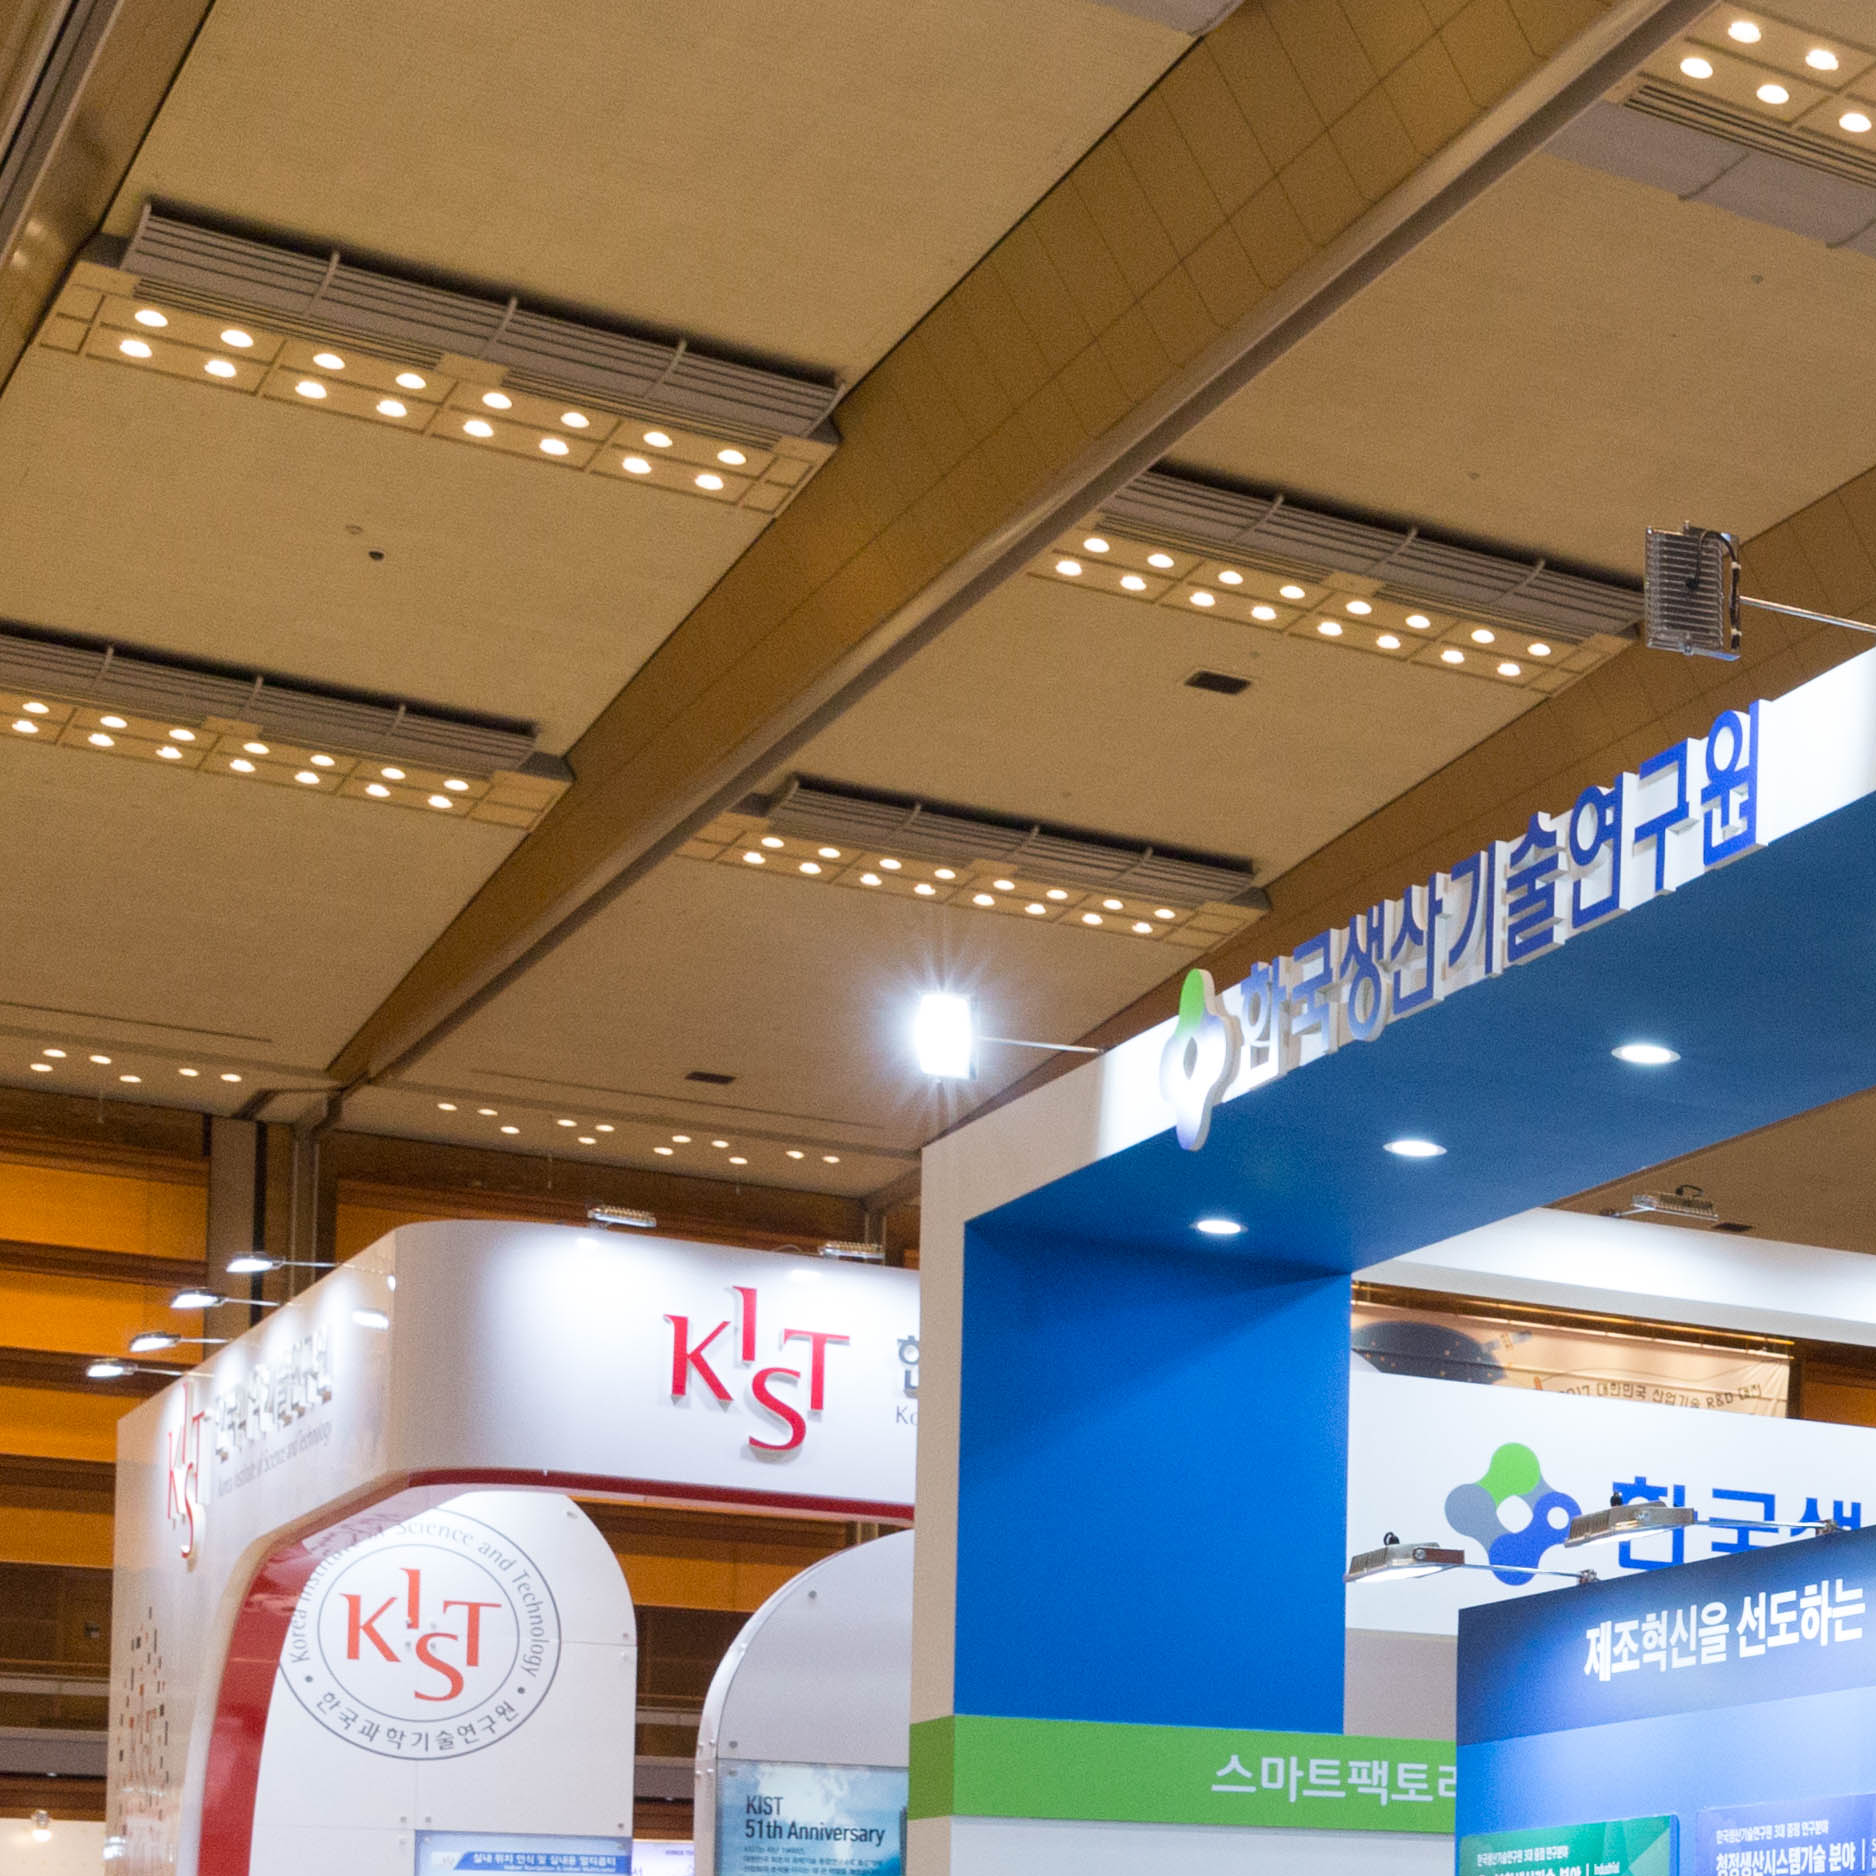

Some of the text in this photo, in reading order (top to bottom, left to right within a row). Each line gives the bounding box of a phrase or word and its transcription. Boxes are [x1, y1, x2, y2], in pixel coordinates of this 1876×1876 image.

[1240, 700, 1767, 1077] 한국생산기술연구원
[664, 1286, 850, 1452] KIST
[1596, 1383, 1647, 1400] 대한민국
[1707, 1392, 1733, 1408] R&D
[339, 1568, 502, 1702] KIST
[478, 1540, 514, 1571] and
[513, 1569, 549, 1678] Technology
[1584, 1600, 1728, 1684] 제조혁신을
[1736, 1580, 1866, 1661] 선도하는
[316, 1691, 520, 1751] 한국과학기술연구원
[745, 1819, 885, 1847] 51th Anniversary
[746, 1795, 783, 1816] KIST
[1828, 1842, 1856, 1872] 분야
